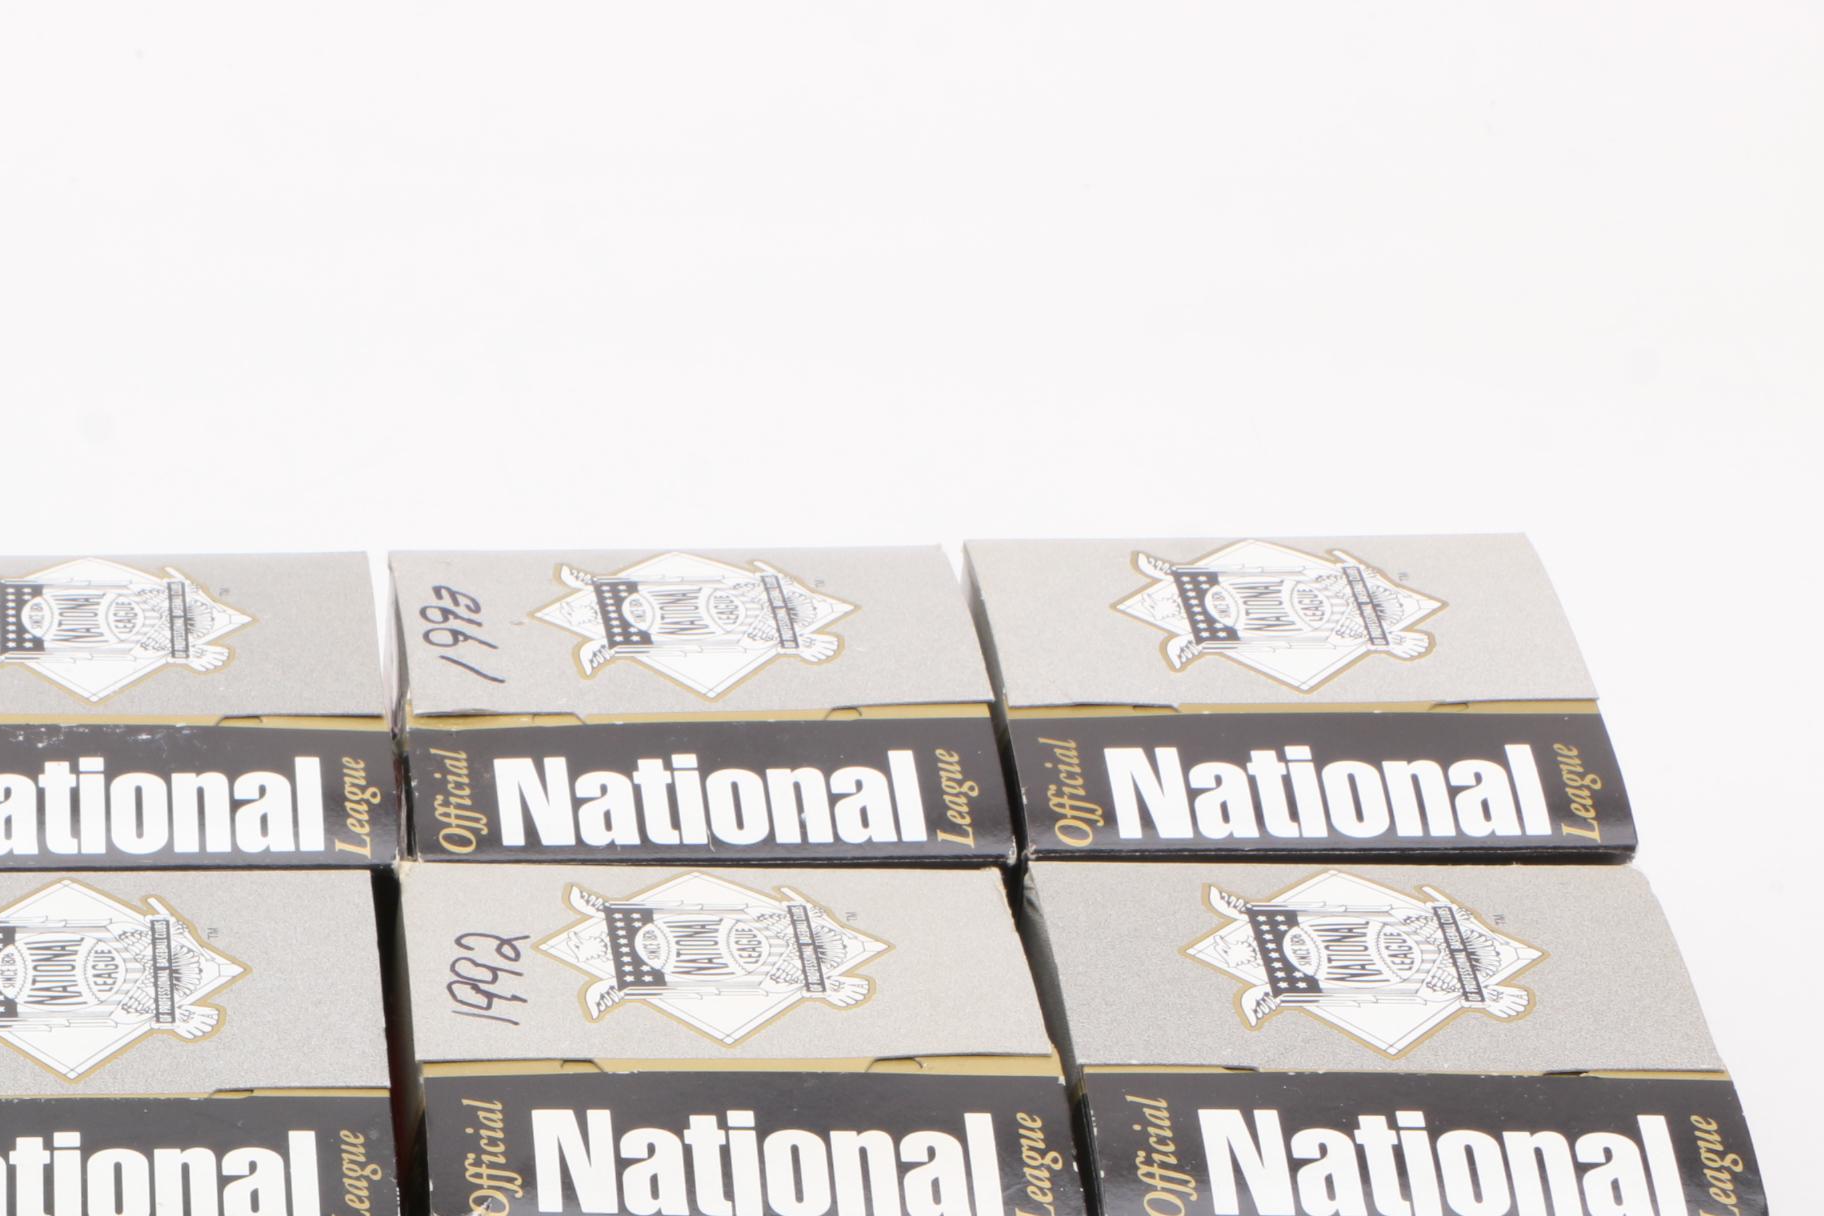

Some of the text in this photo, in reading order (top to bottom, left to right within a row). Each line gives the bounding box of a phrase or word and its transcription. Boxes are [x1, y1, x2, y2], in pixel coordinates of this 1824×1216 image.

[422, 585, 506, 683] 1993
[334, 756, 381, 859] League
[430, 749, 979, 854] Official National League
[1037, 738, 1602, 847] Official National League
[24, 937, 88, 1005] NATIONAL
[92, 950, 118, 991] LEAGUE
[447, 932, 530, 1026] 1992
[663, 918, 735, 975] NATIONAL
[735, 929, 762, 964] LEAGUE
[1309, 921, 1390, 982] NATIONAL
[1384, 932, 1414, 971] LEAGUE
